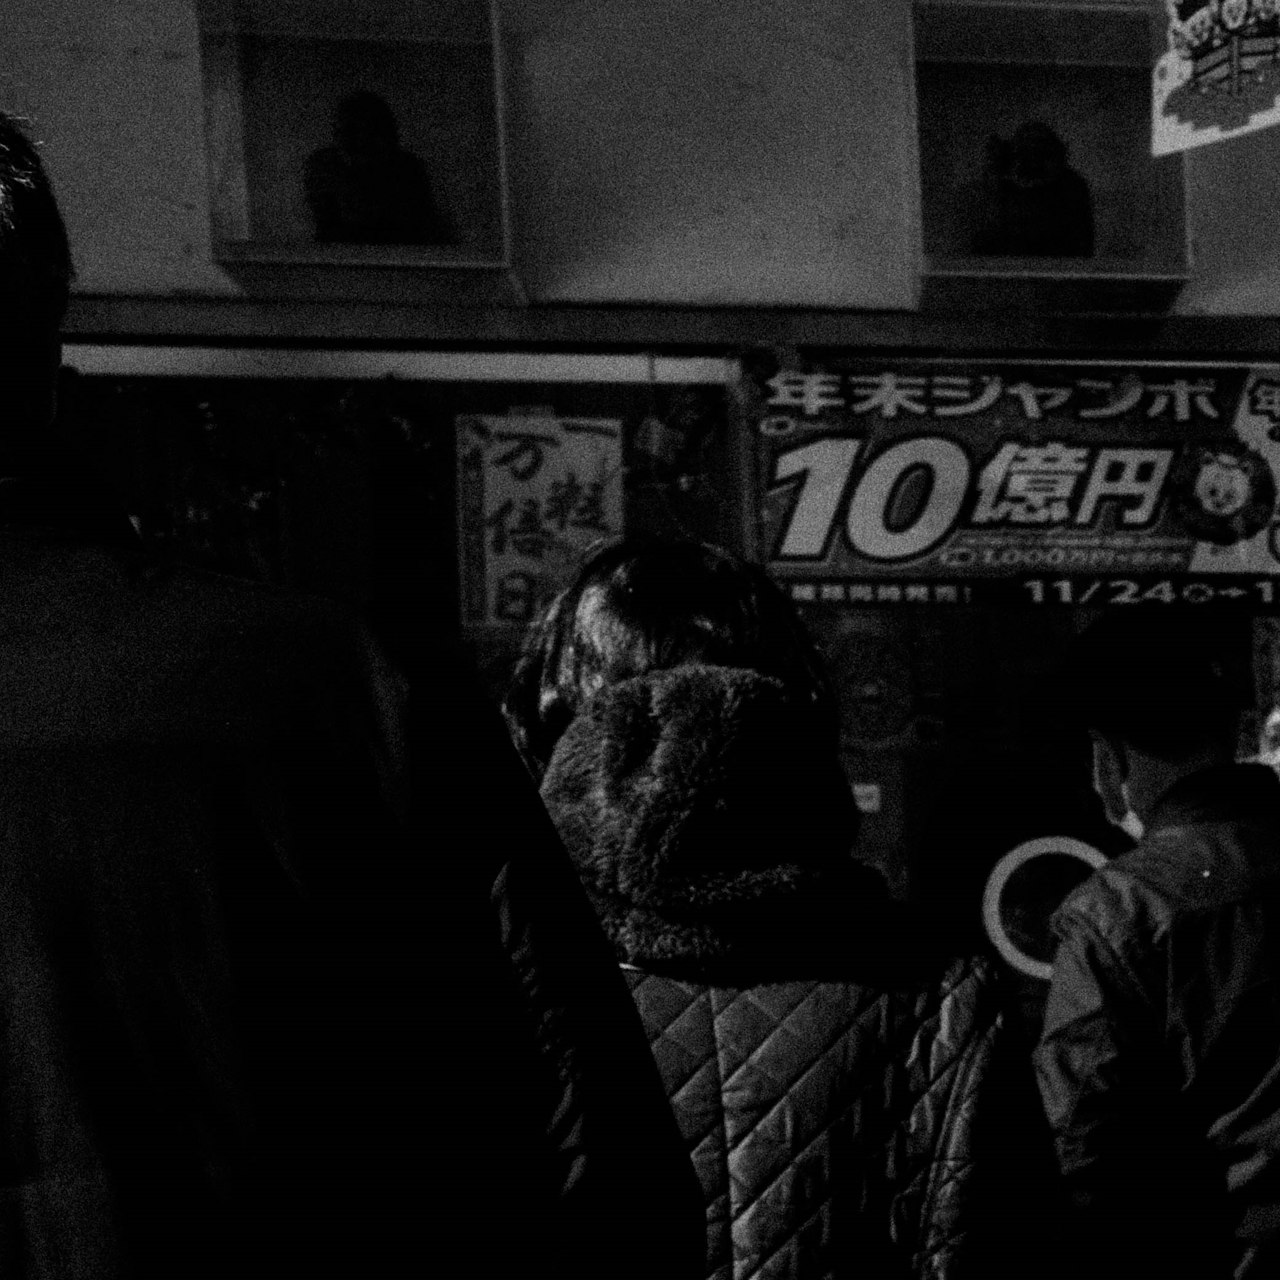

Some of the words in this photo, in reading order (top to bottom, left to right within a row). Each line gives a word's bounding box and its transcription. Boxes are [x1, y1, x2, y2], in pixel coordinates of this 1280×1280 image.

[766, 372, 1220, 422] 年末ジャンボ
[766, 435, 1177, 562] 10億円
